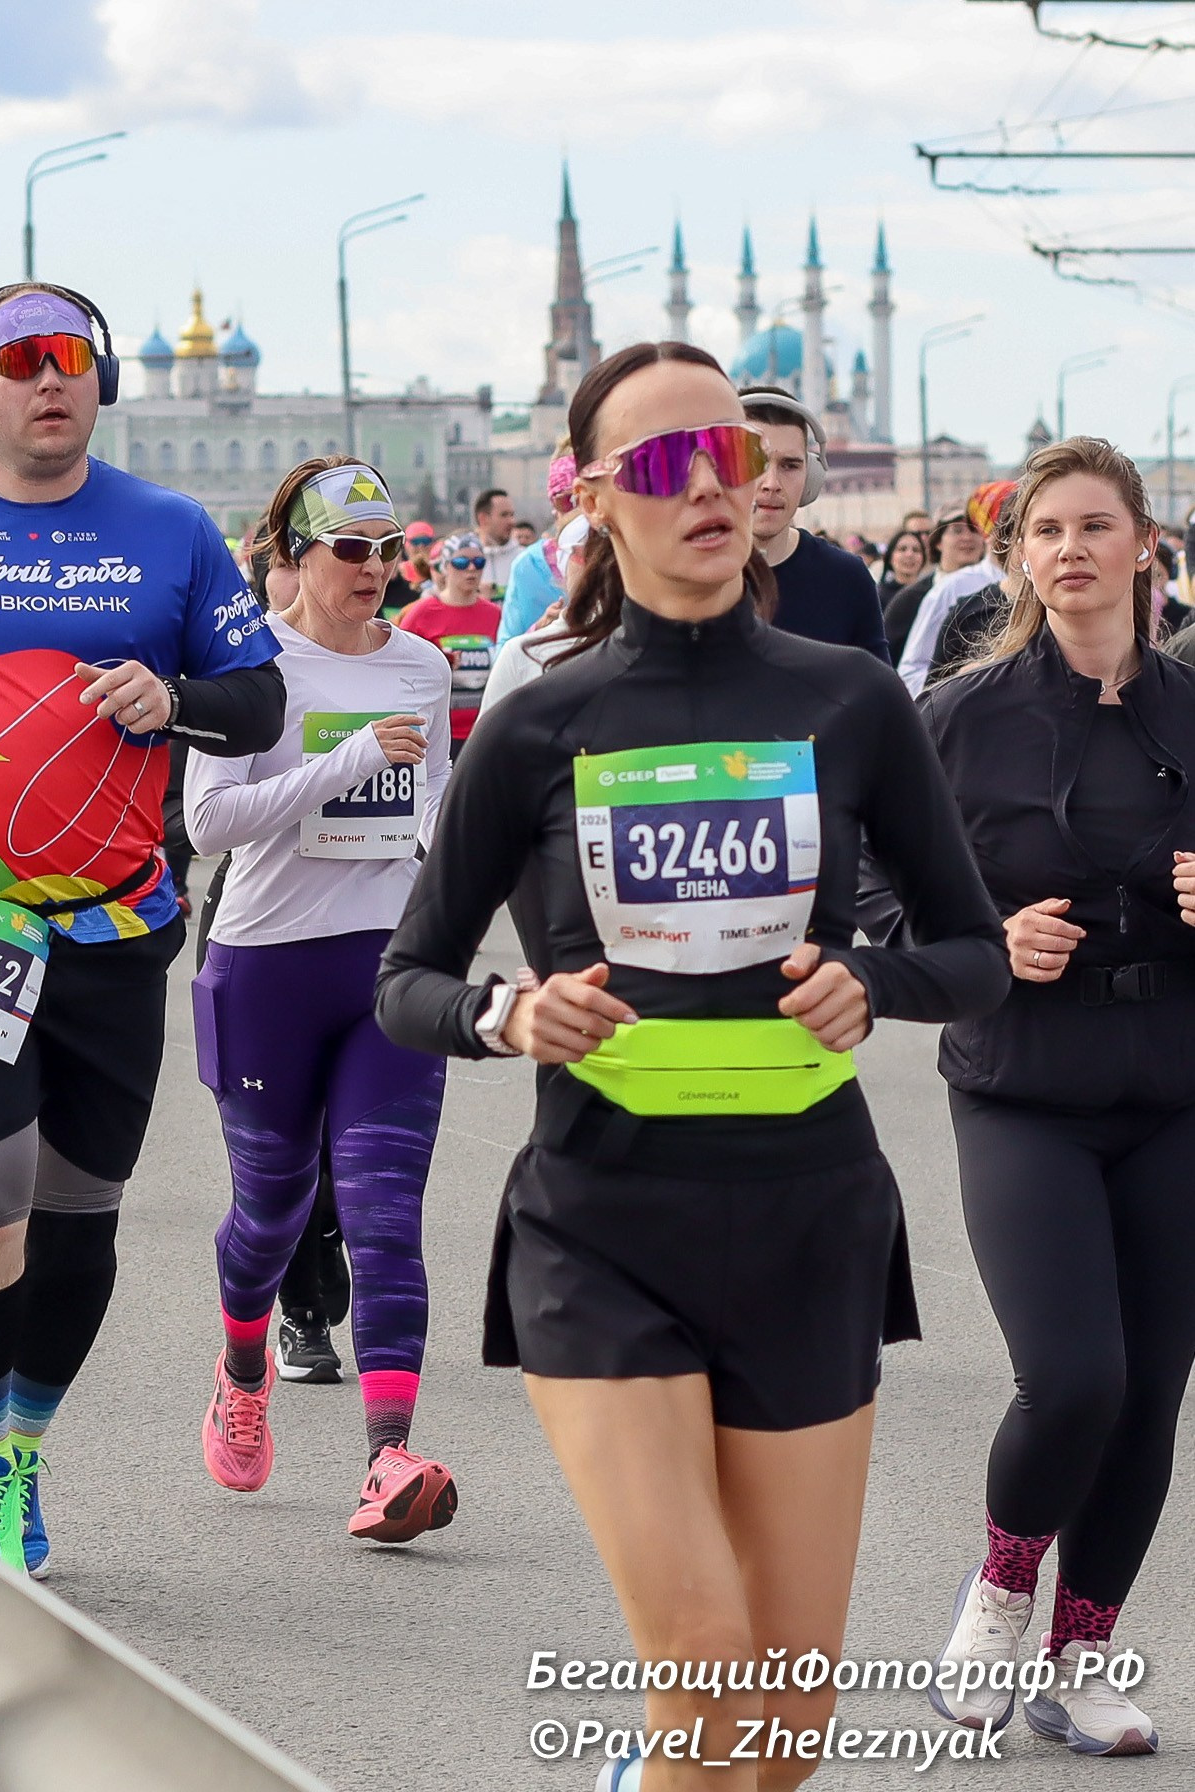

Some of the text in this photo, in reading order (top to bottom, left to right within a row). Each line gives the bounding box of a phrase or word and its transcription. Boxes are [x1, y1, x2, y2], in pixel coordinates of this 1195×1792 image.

[54, 556, 143, 590] забег
[617, 769, 654, 783] СБЕР
[580, 815, 608, 825] 2026
[330, 835, 365, 843] МАГНИТ
[628, 818, 777, 881] 32466
[676, 879, 730, 899] ЕЛЕНА
